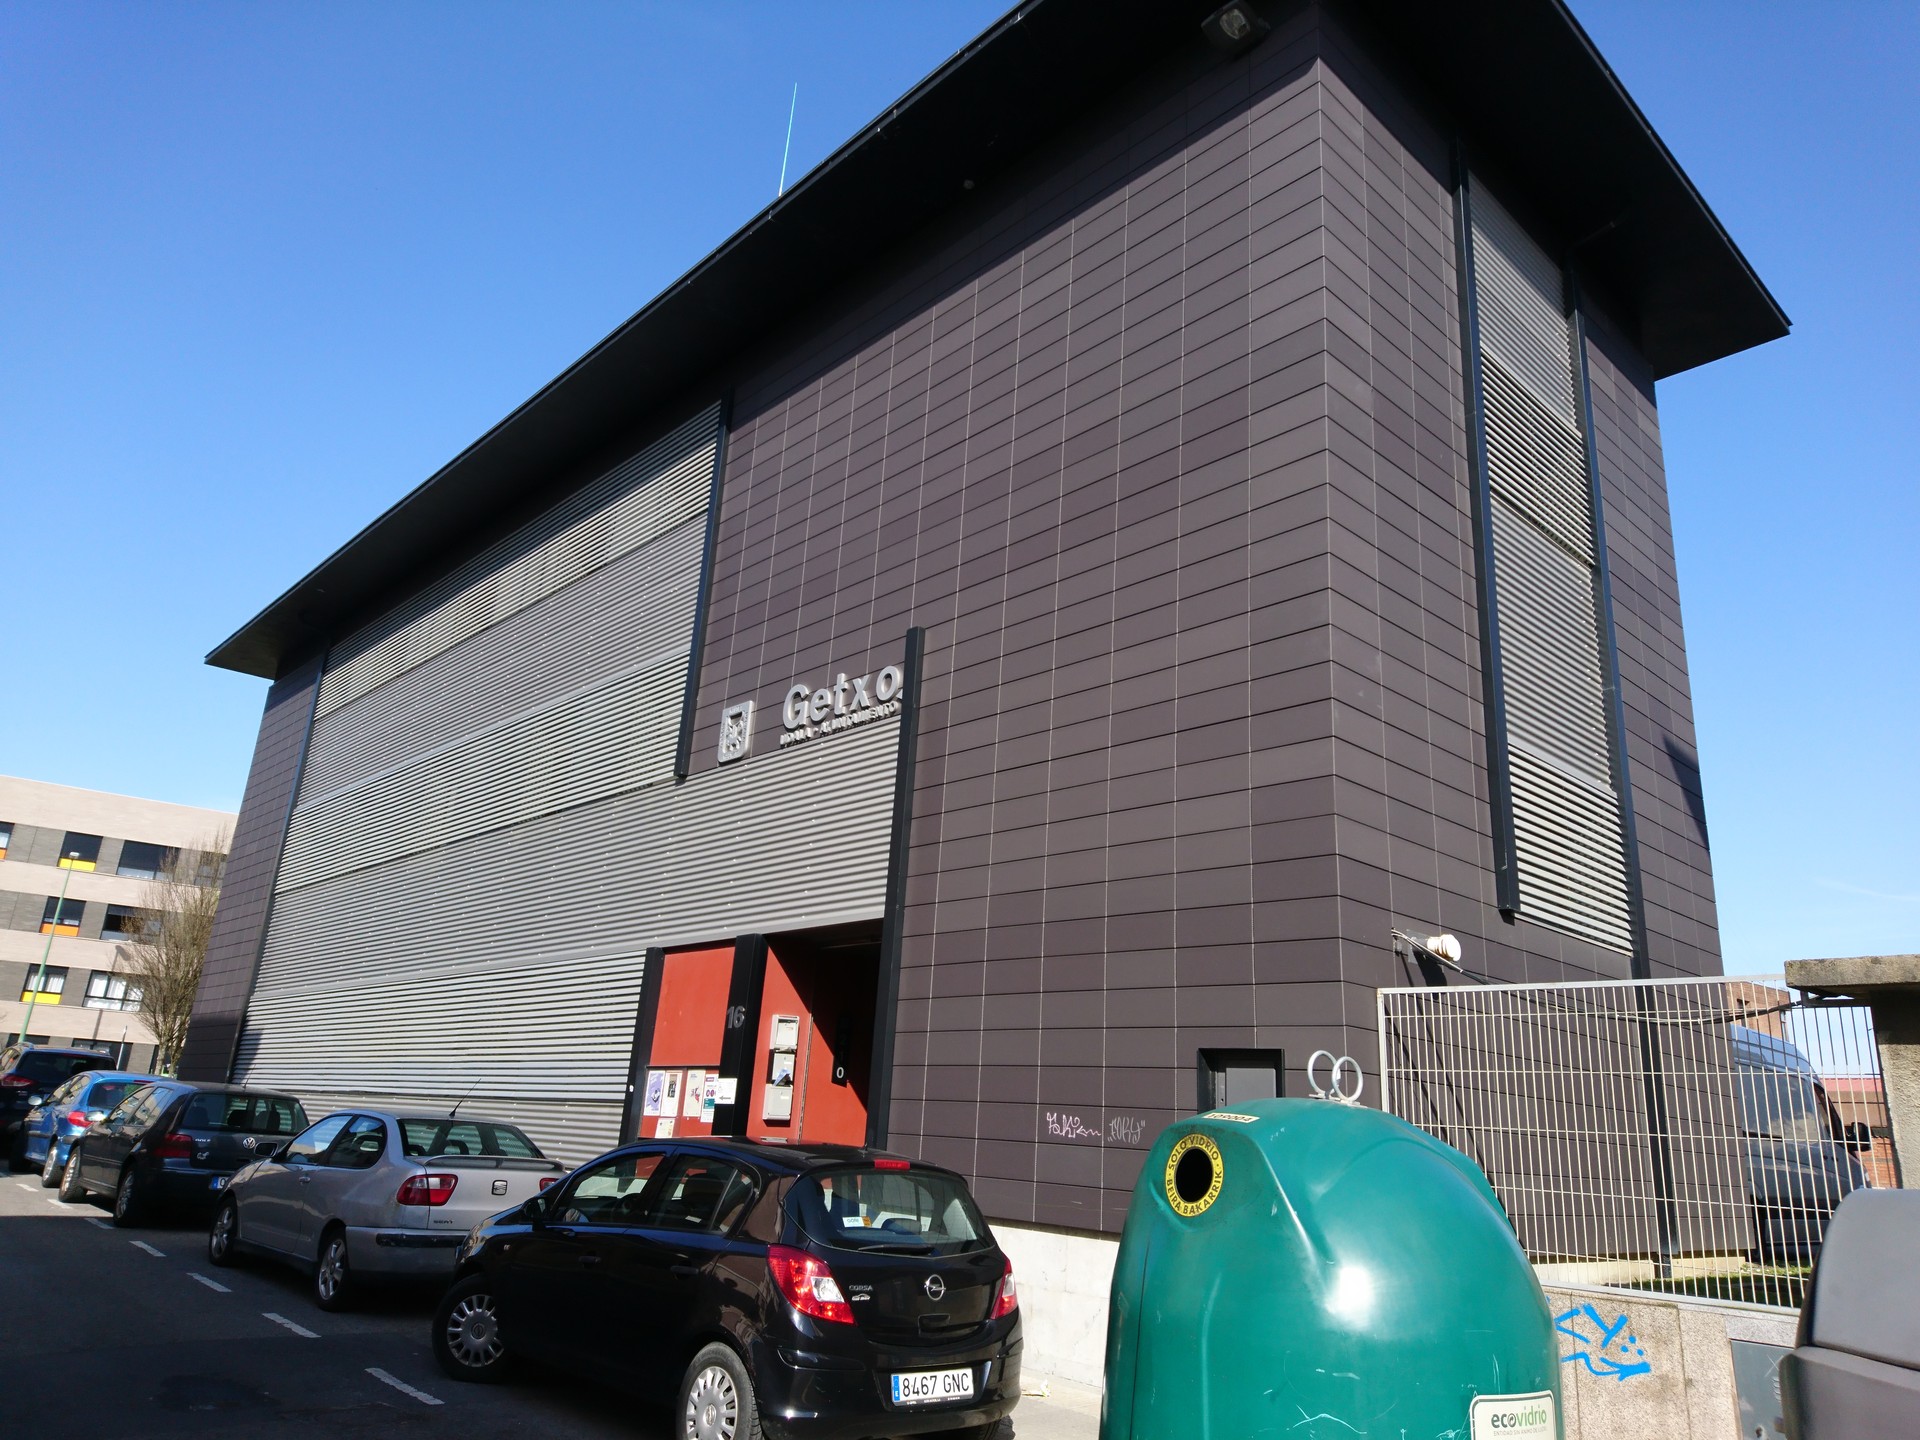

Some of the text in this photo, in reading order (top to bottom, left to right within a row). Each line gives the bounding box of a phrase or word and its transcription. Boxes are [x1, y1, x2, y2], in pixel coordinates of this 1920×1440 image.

[783, 665, 900, 729] Getxo
[727, 1005, 745, 1029] 16
[836, 1066, 844, 1079] 0
[1168, 1136, 1219, 1171] SOLO VIDRIO
[1167, 1170, 1222, 1214] BEIRA BAKARRIK
[903, 1375, 938, 1397] 8467
[943, 1372, 969, 1394] GNC
[1491, 1405, 1547, 1428] ecovidrio
